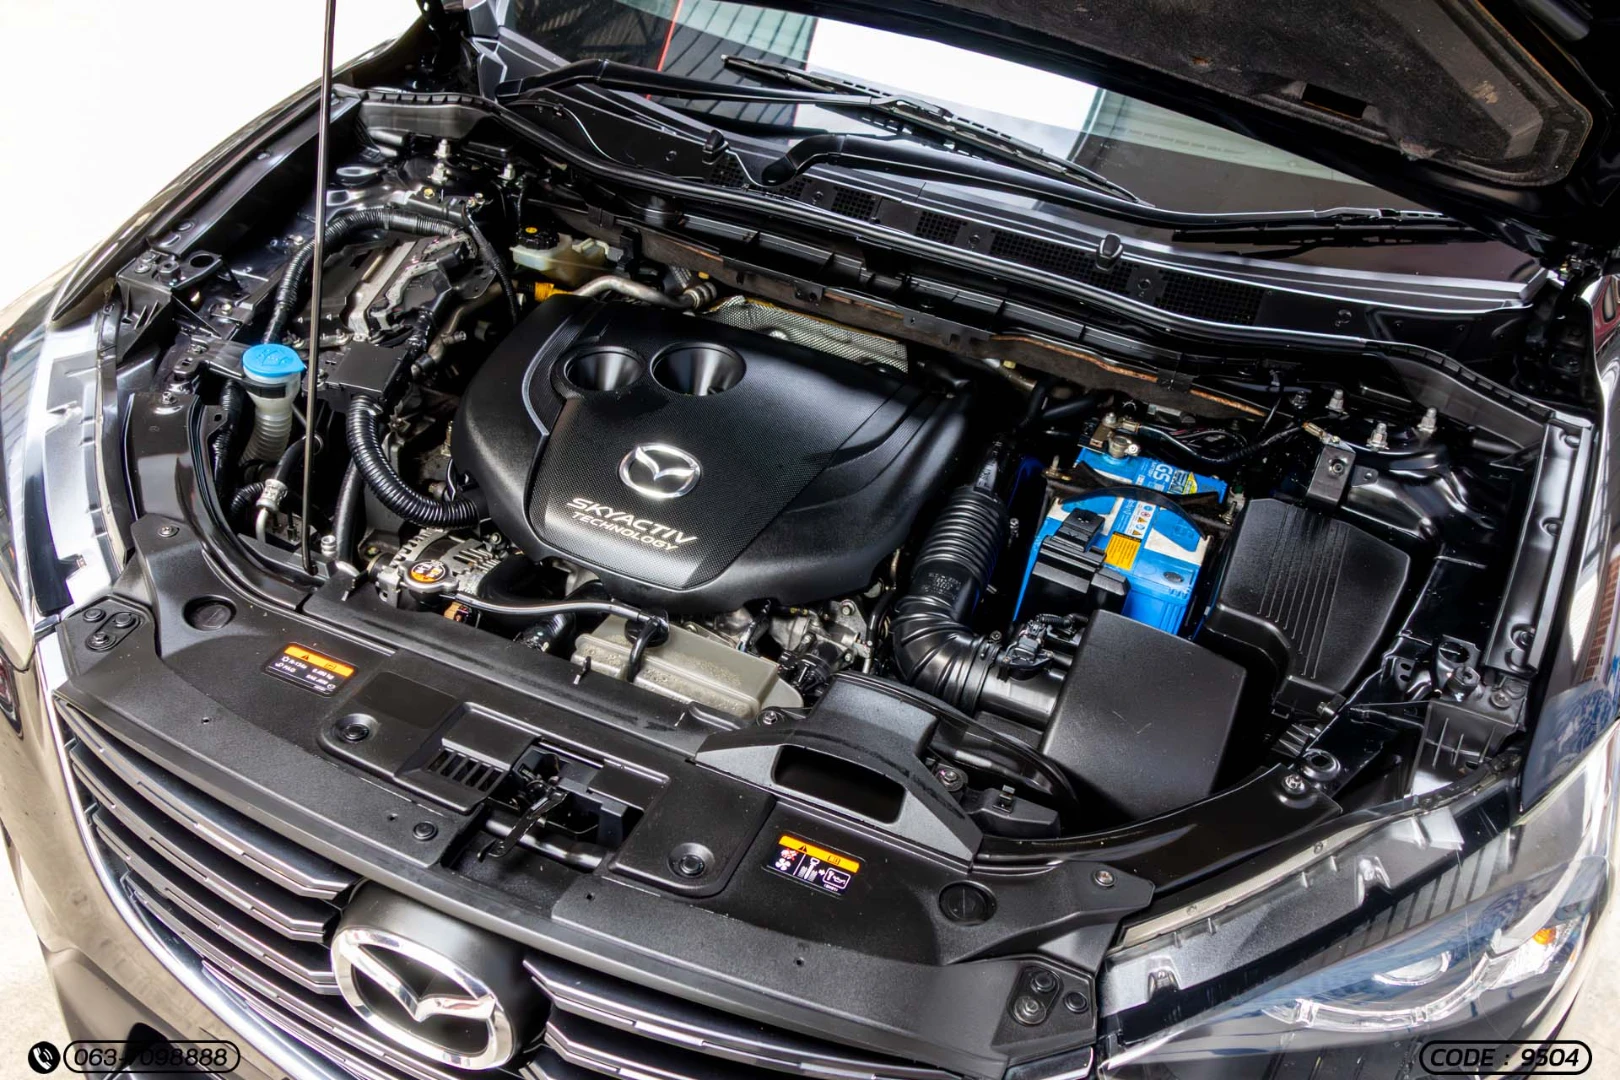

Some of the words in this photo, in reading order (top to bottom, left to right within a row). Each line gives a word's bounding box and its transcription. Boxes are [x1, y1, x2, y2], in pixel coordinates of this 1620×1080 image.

[1152, 463, 1173, 482] GS
[566, 497, 699, 544] SKYACTIV
[571, 511, 680, 551] TECHNOLOGY
